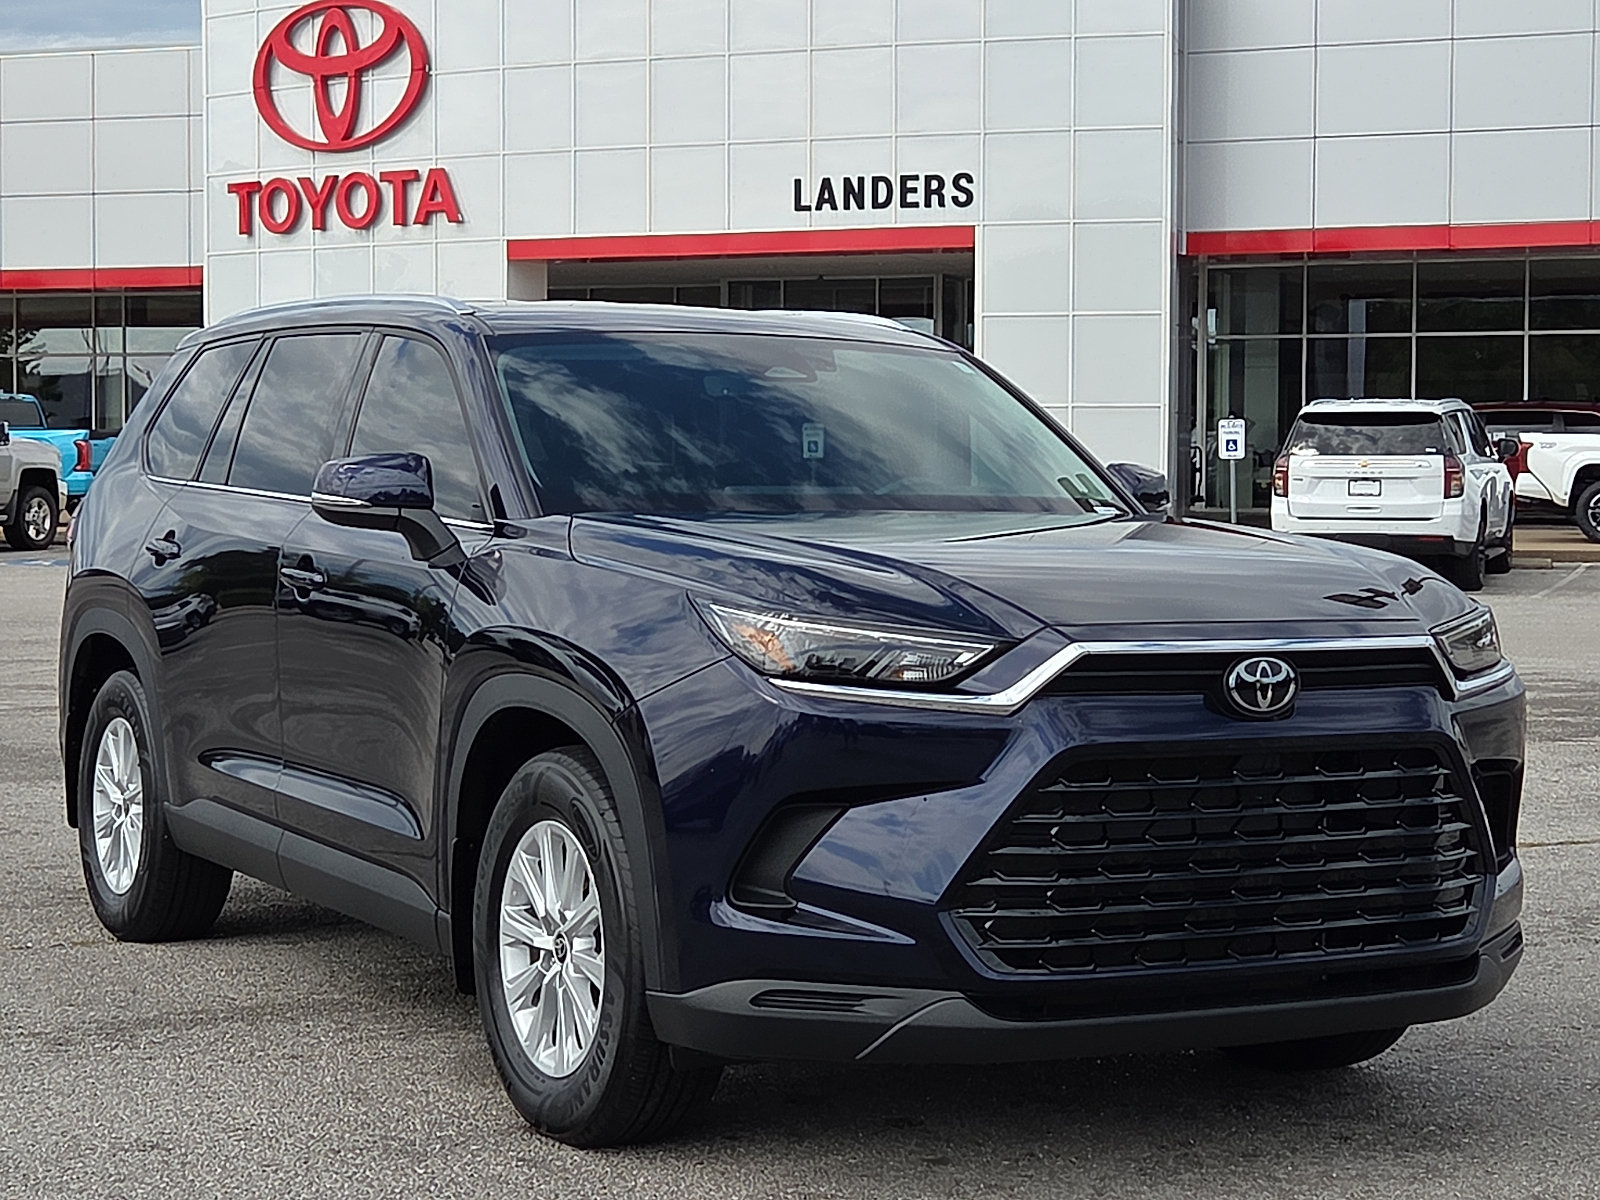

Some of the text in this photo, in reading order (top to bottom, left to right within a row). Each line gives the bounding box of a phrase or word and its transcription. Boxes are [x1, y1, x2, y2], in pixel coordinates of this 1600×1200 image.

[227, 168, 463, 236] TOYOTA
[793, 172, 974, 212] LANDERS
[566, 989, 616, 1119] ASSURAN
